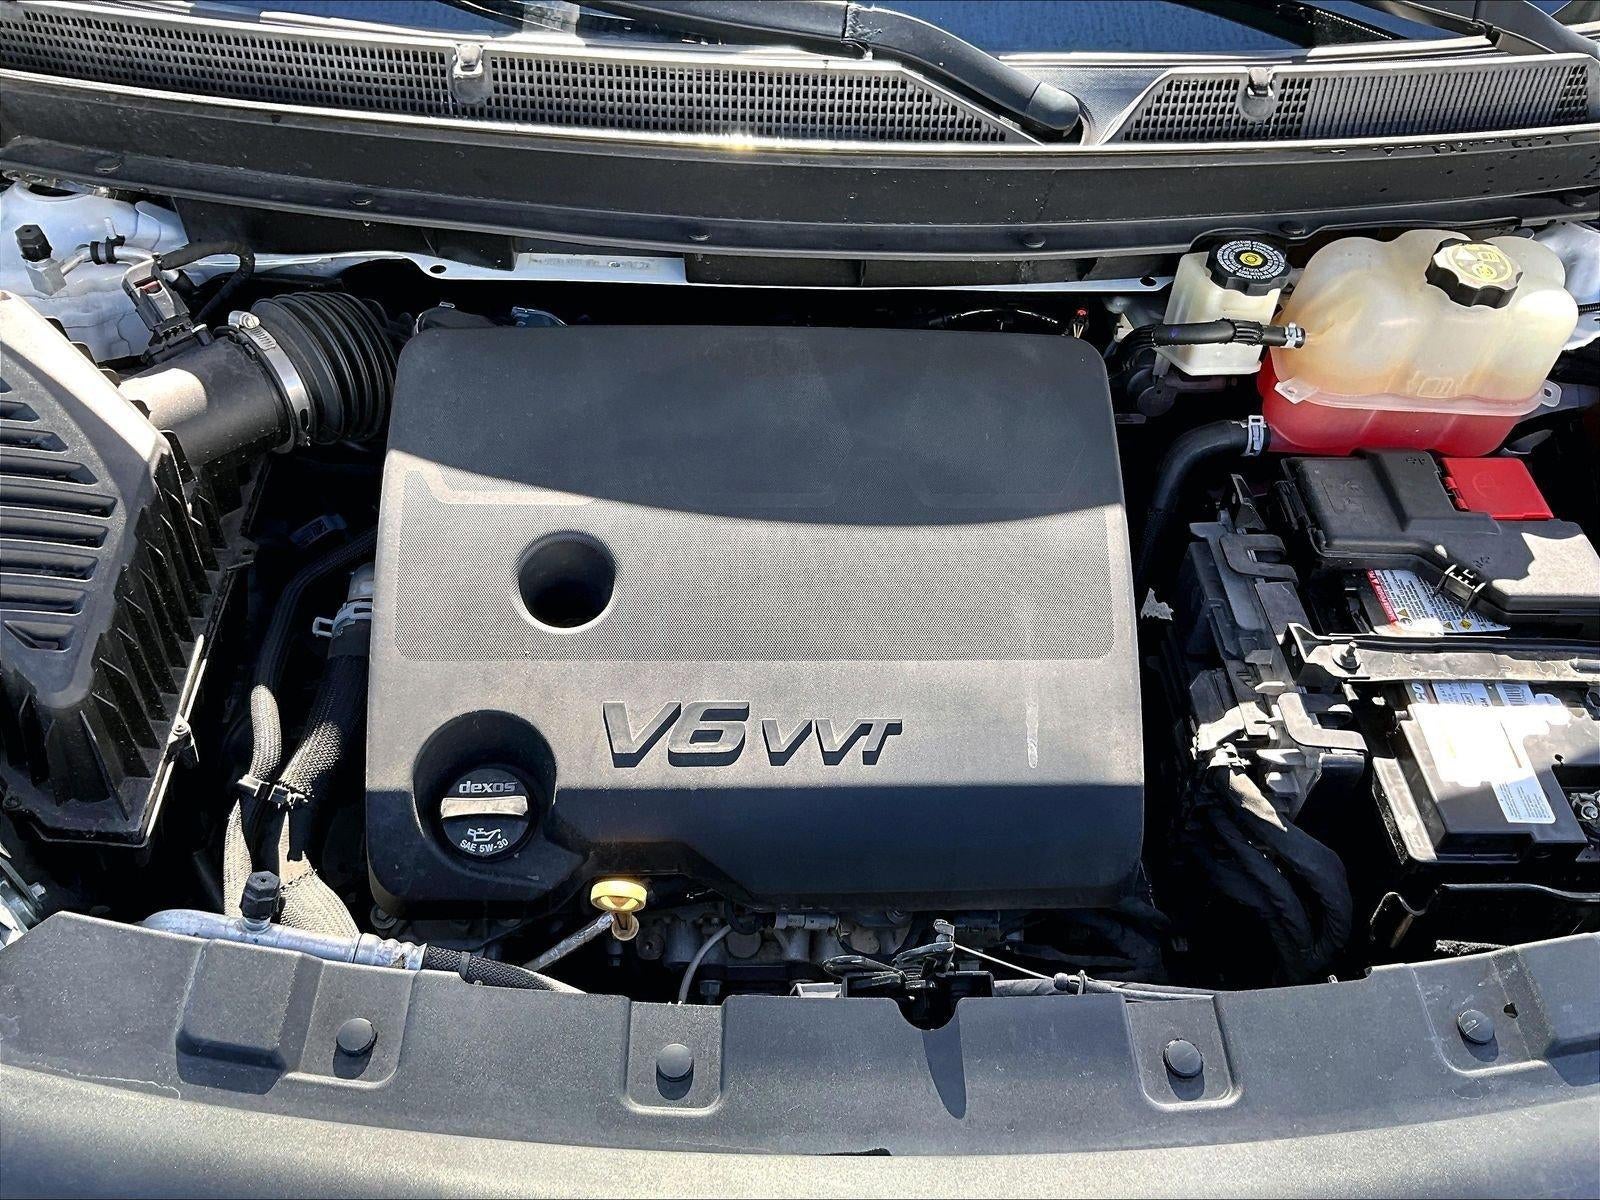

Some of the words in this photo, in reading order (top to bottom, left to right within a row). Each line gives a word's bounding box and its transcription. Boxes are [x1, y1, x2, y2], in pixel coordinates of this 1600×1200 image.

[602, 700, 749, 768] V6
[761, 718, 903, 766] VVT
[458, 780, 517, 793] dexos
[460, 839, 477, 852] SAE
[479, 838, 509, 853] 5W-30
